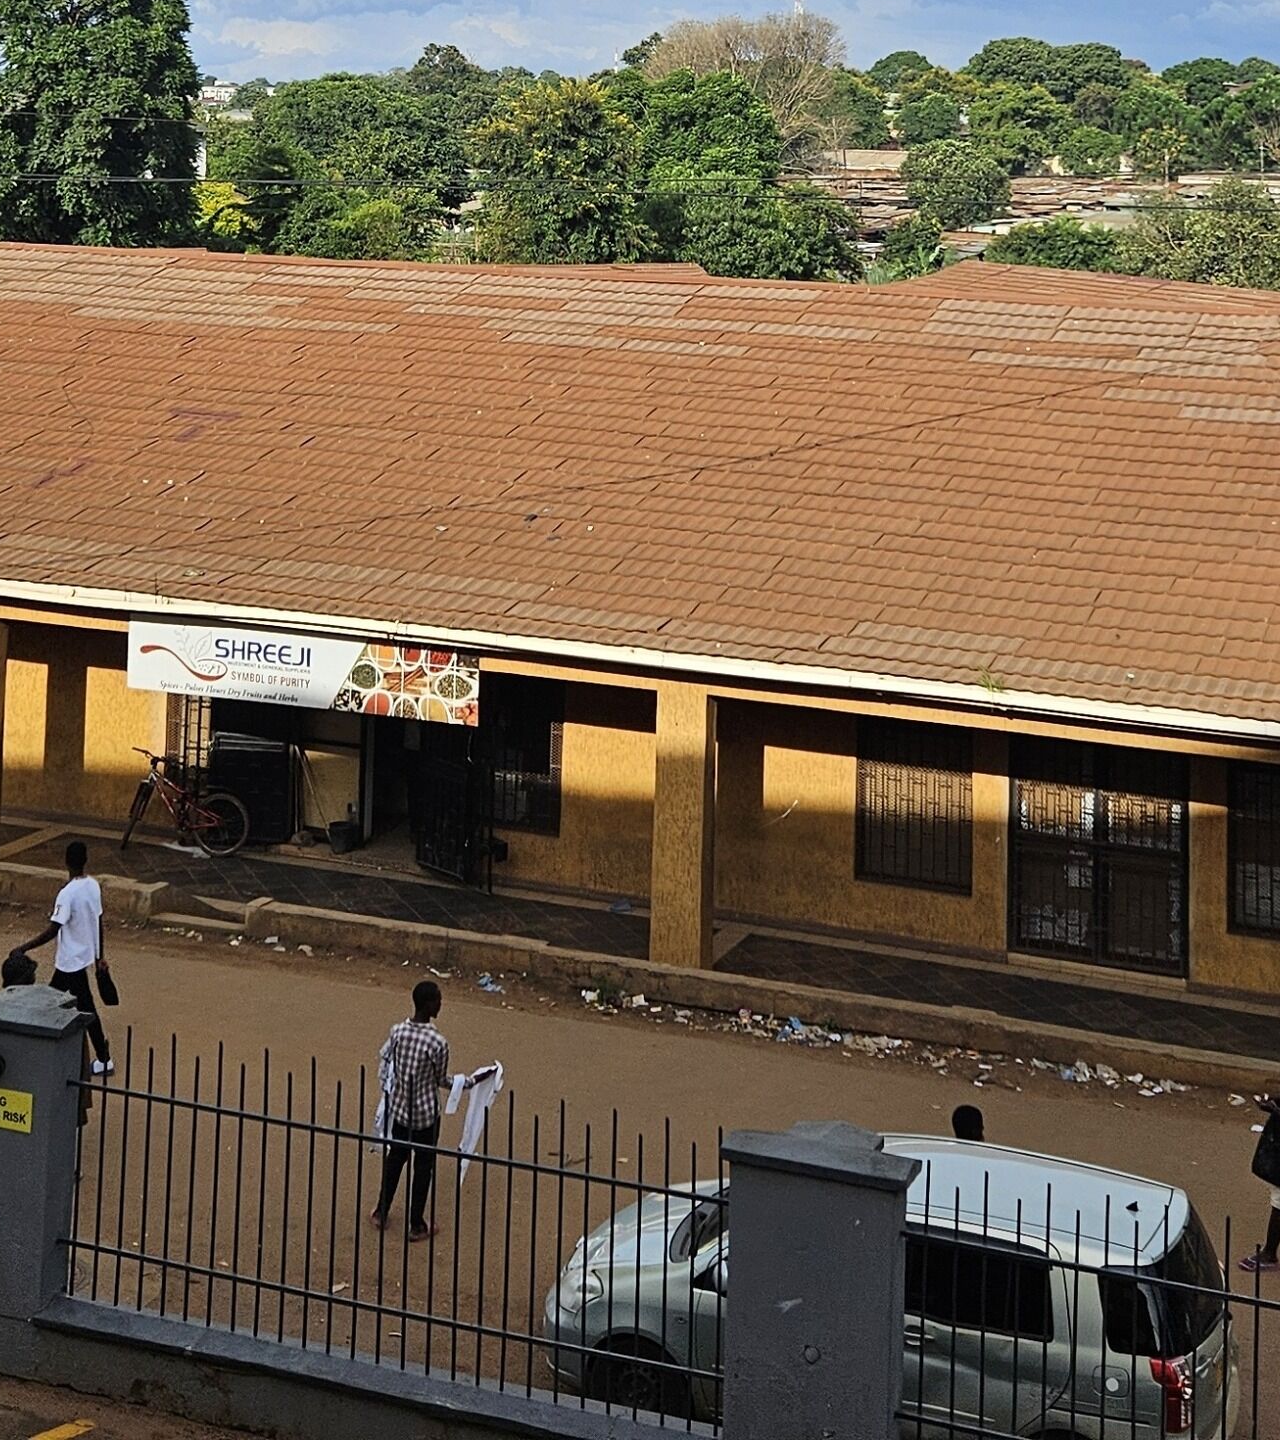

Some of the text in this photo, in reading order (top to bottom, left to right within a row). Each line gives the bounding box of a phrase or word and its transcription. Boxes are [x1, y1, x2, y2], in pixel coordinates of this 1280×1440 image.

[215, 638, 312, 667] SHREEJI
[262, 664, 284, 672] GENERAL
[285, 666, 311, 674] SUPPLIERS
[231, 671, 311, 689] SYMBOL OF PURITY
[160, 680, 179, 690] Spices
[184, 683, 204, 693] Pulses
[227, 687, 241, 698] Dry
[242, 688, 263, 699] Fruits
[263, 691, 277, 700] and
[278, 692, 299, 703] Herbs
[2, 1111, 26, 1125] RISK
